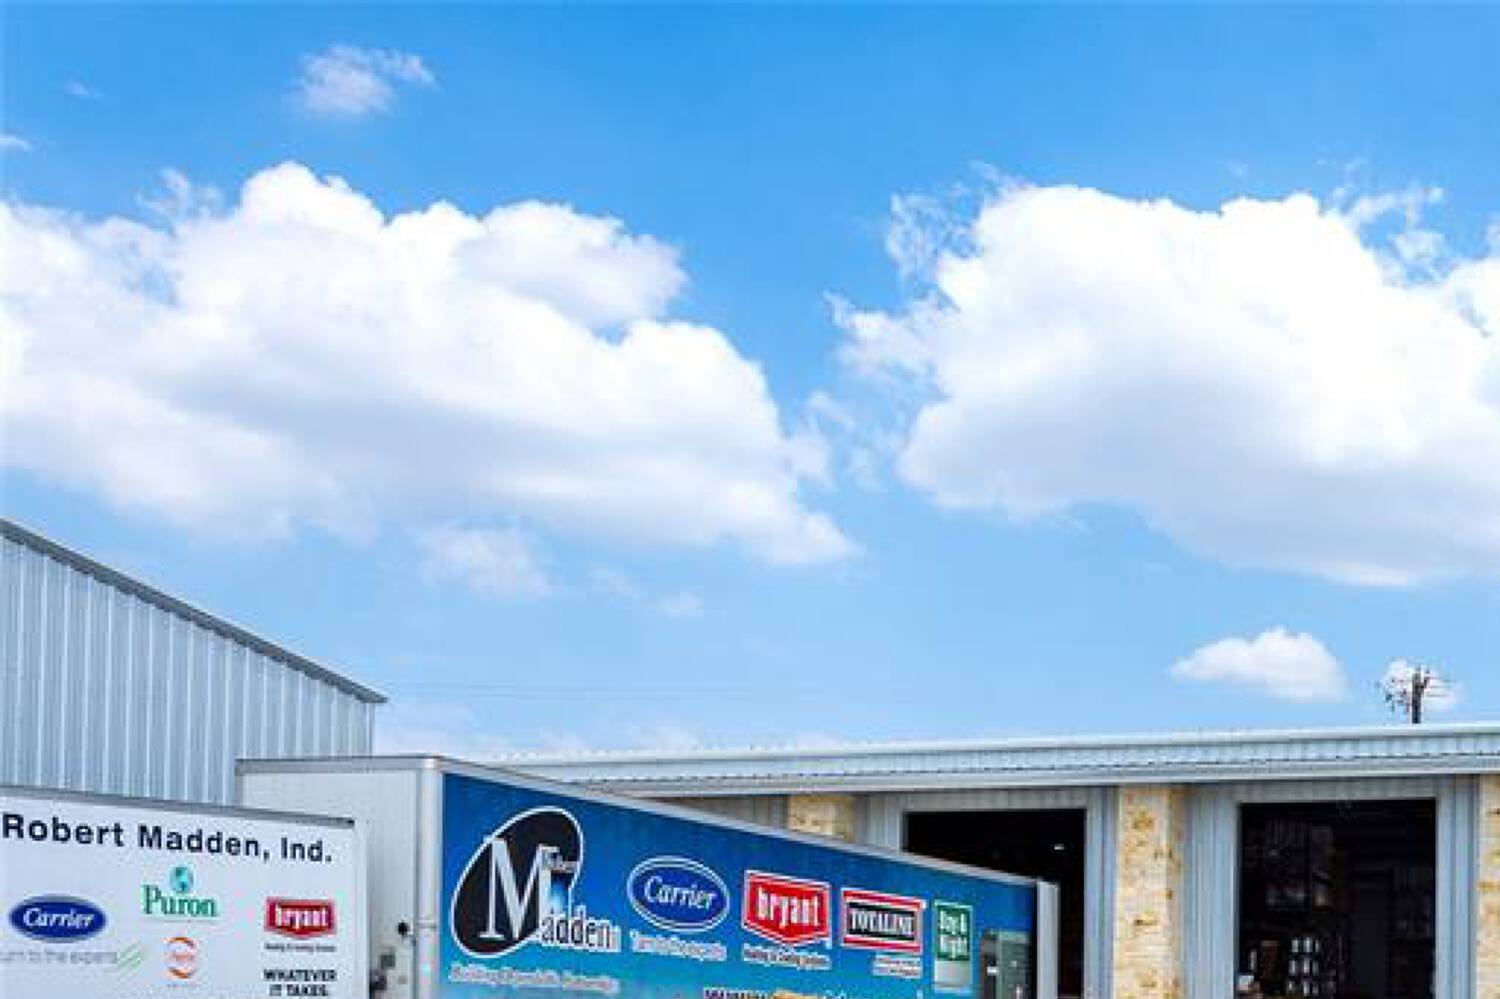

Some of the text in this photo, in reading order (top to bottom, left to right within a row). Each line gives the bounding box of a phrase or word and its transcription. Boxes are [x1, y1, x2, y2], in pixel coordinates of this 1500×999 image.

[2, 813, 332, 862] Robert Madden, Ind.
[142, 884, 217, 917] Puron
[643, 875, 718, 909] Carrier
[22, 907, 95, 928] Carrier
[275, 904, 329, 930] bryant
[758, 887, 819, 928] bryant
[850, 908, 914, 935] TOTALINE
[263, 970, 337, 982] WHATEVER
